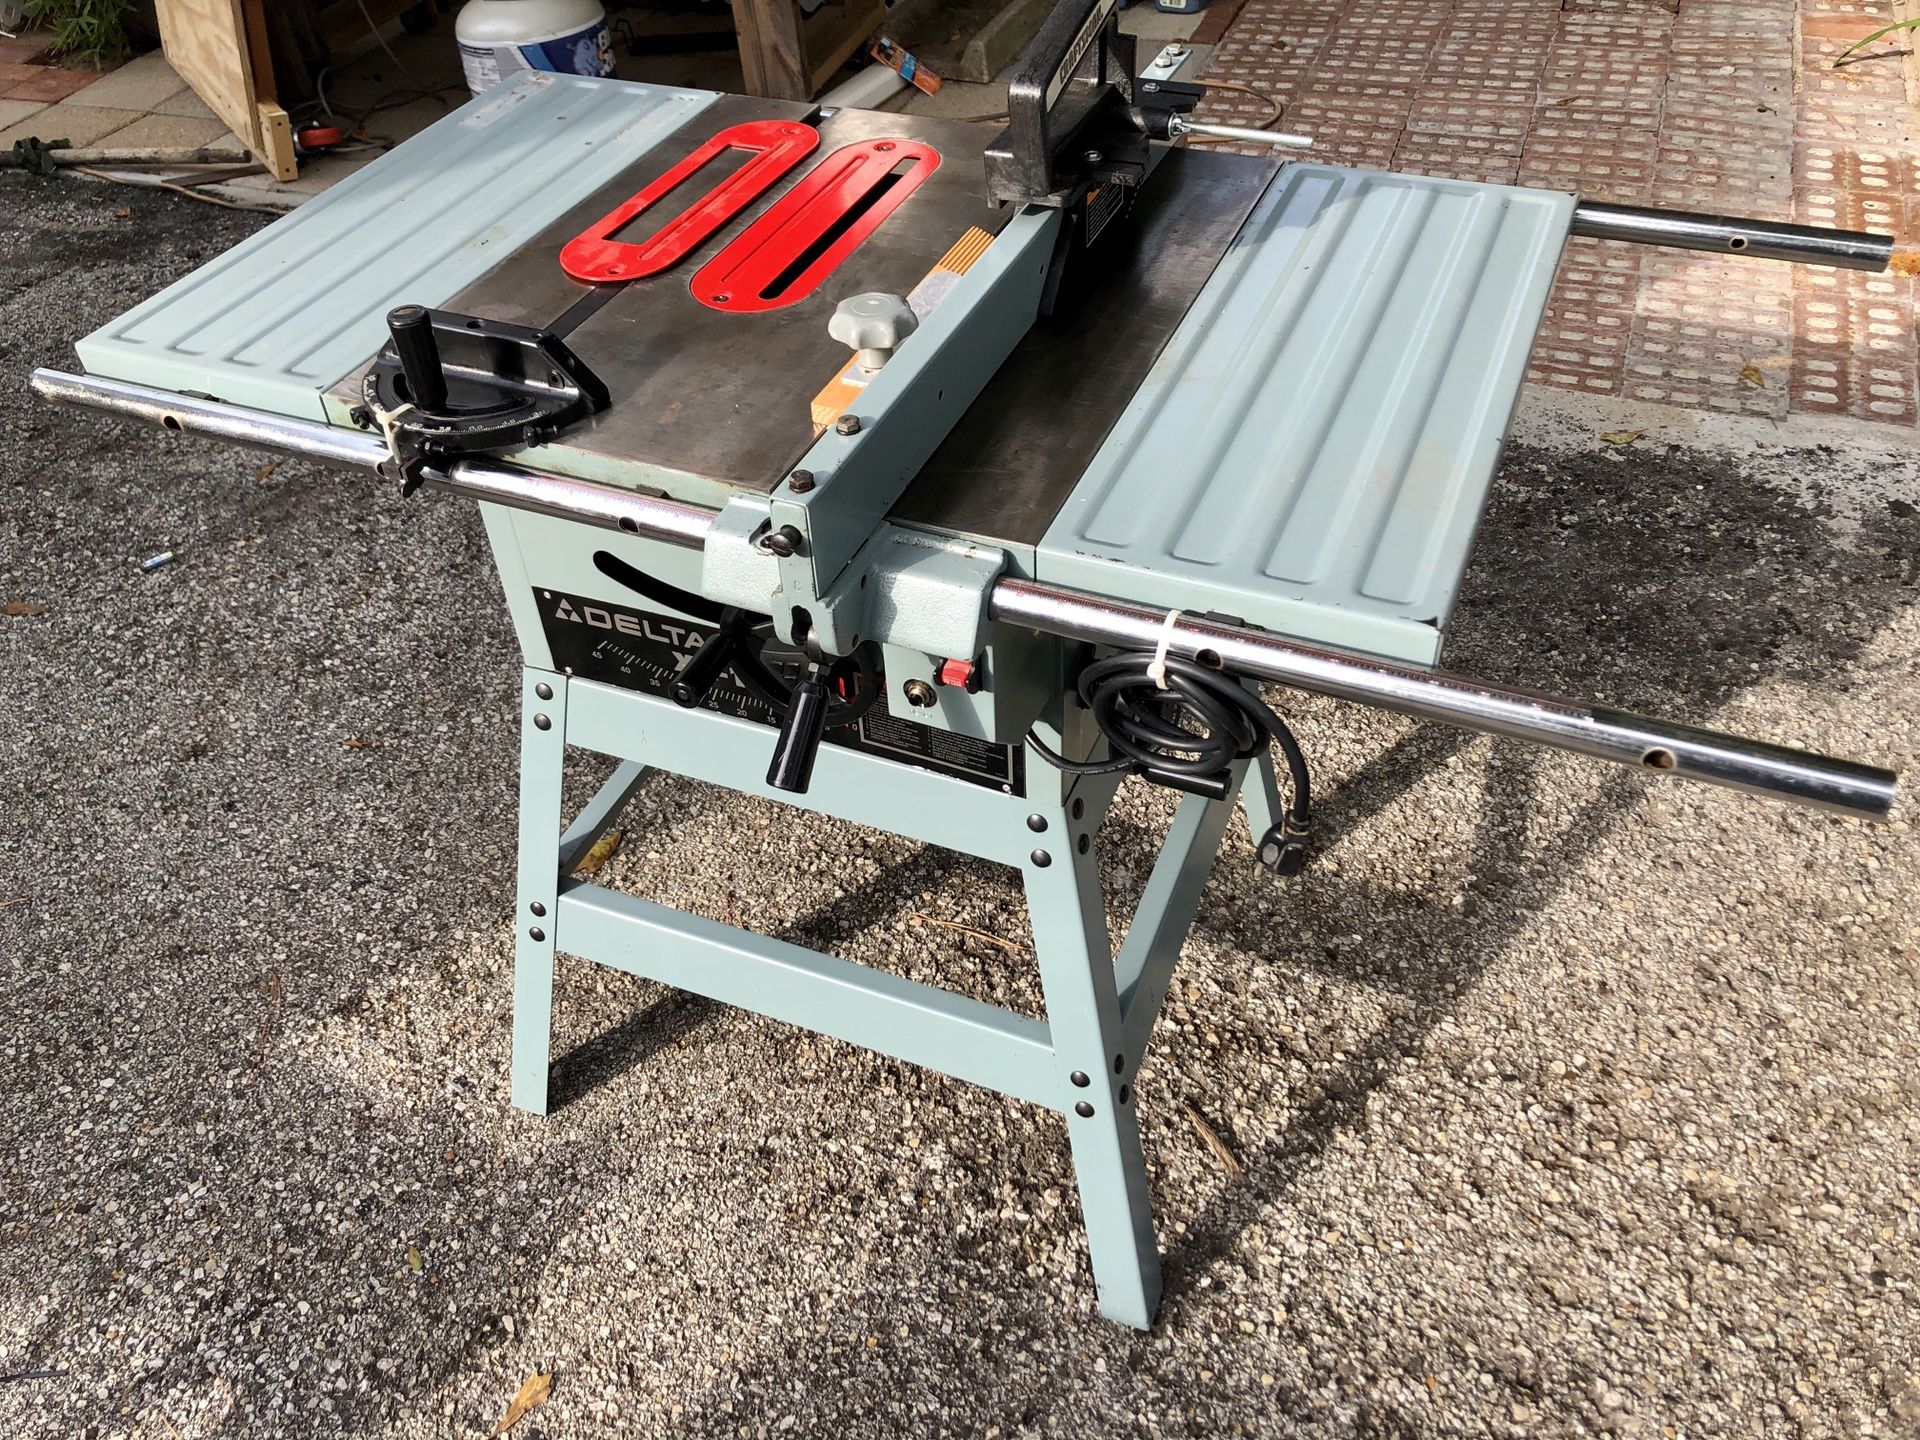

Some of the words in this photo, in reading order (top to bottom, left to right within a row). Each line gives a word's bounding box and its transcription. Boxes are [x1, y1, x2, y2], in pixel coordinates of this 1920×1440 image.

[583, 606, 705, 649] DELTA
[592, 650, 603, 659] 45
[620, 665, 632, 674] 40
[649, 678, 661, 687] 35
[708, 700, 719, 709] 25
[736, 708, 748, 717] 20
[766, 716, 777, 724] 15
